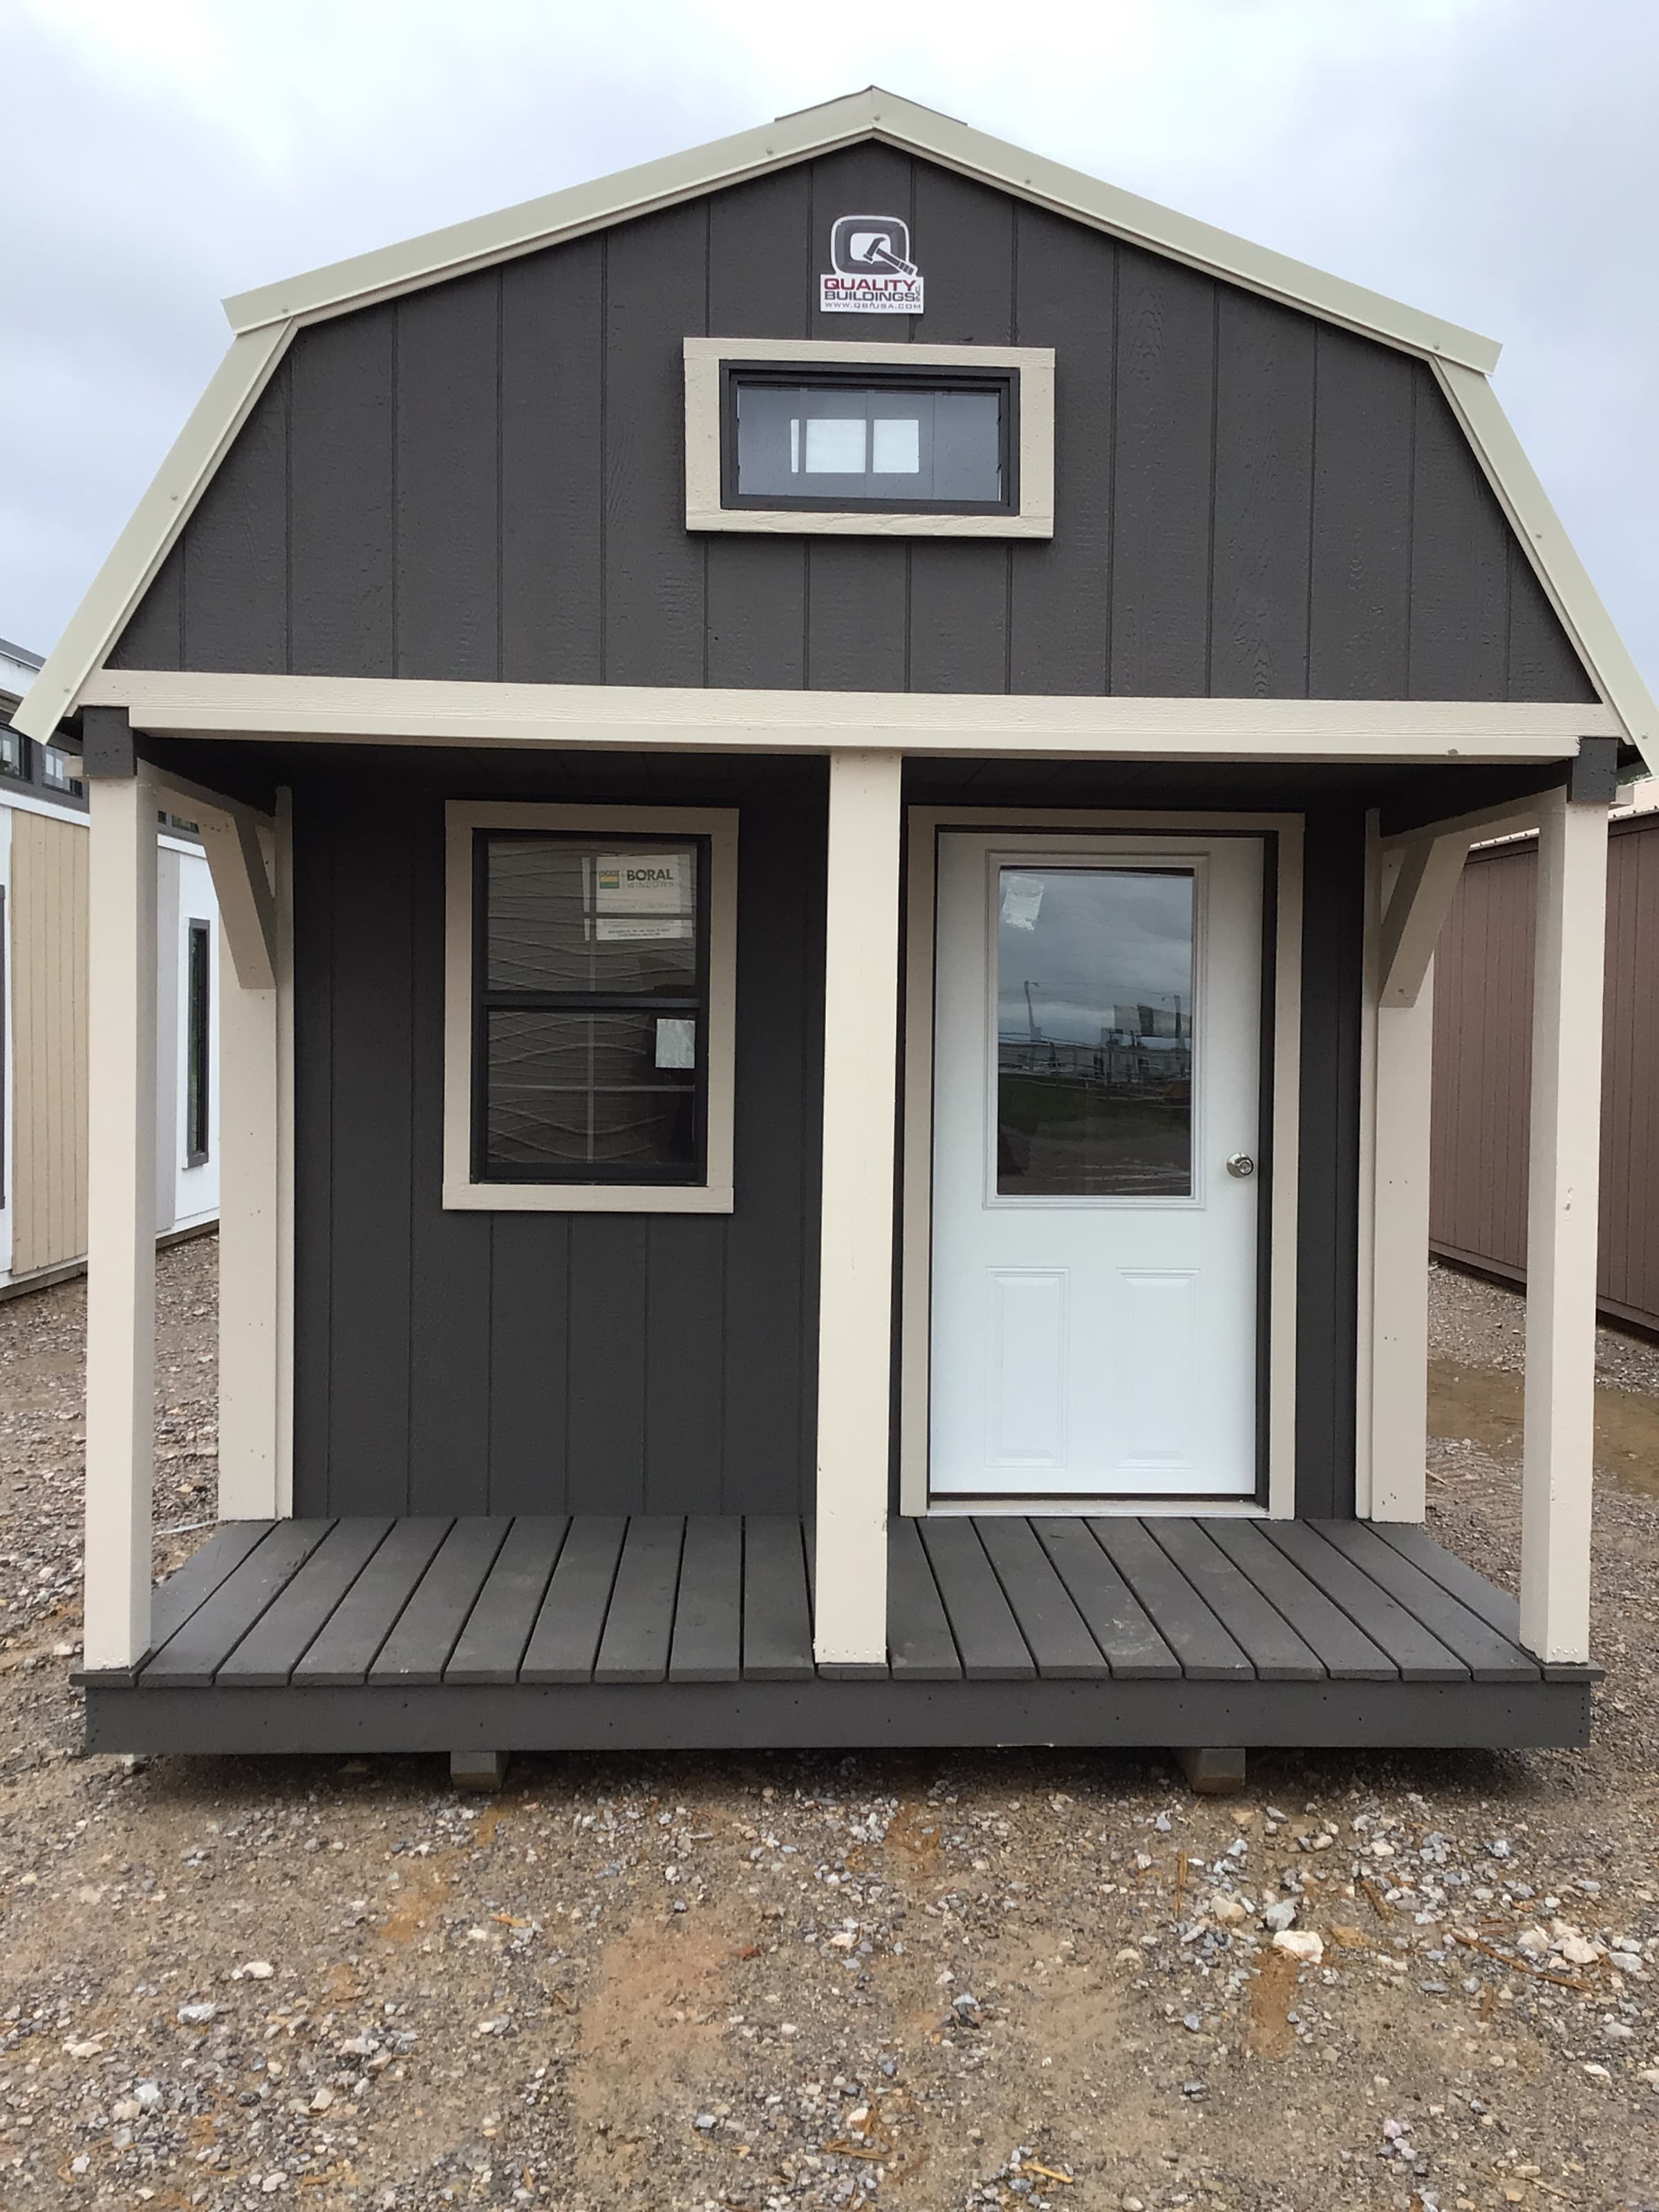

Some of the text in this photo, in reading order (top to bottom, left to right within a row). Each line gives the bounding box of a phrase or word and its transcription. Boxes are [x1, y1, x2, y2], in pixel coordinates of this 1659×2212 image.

[824, 278, 917, 291] QUALITY
[825, 291, 915, 302] BUILDINGS
[626, 869, 674, 881] BORAL
